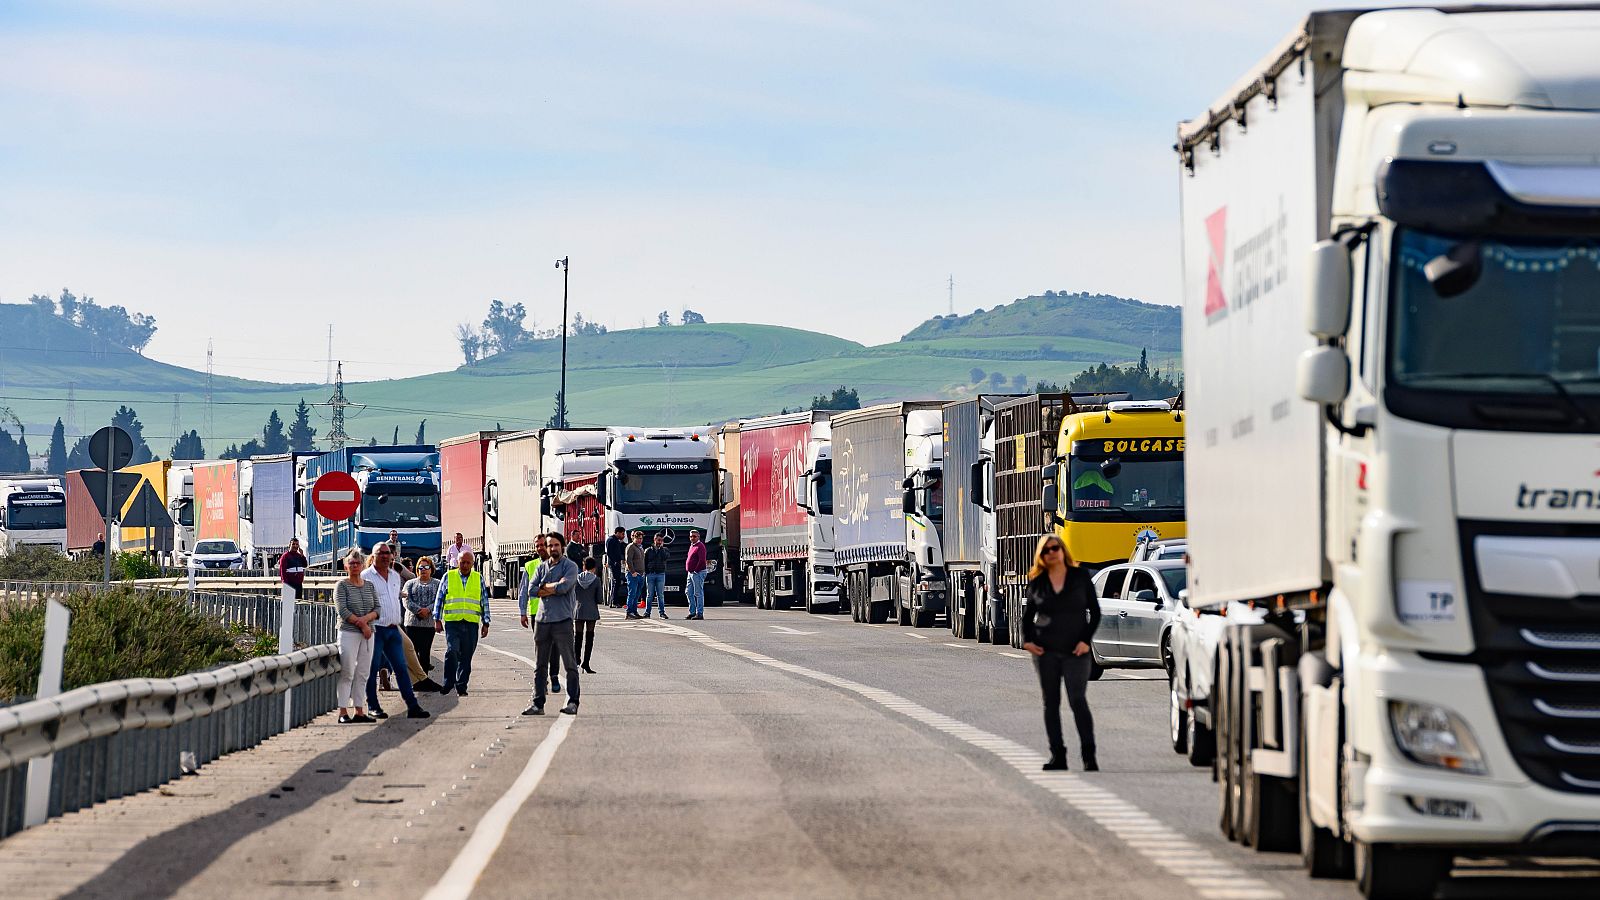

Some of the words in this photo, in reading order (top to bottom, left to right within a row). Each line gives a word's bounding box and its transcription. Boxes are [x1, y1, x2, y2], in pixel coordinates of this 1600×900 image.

[1079, 499, 1105, 508] DIEGO
[1515, 482, 1600, 510] tran
[1427, 592, 1454, 610] TP
